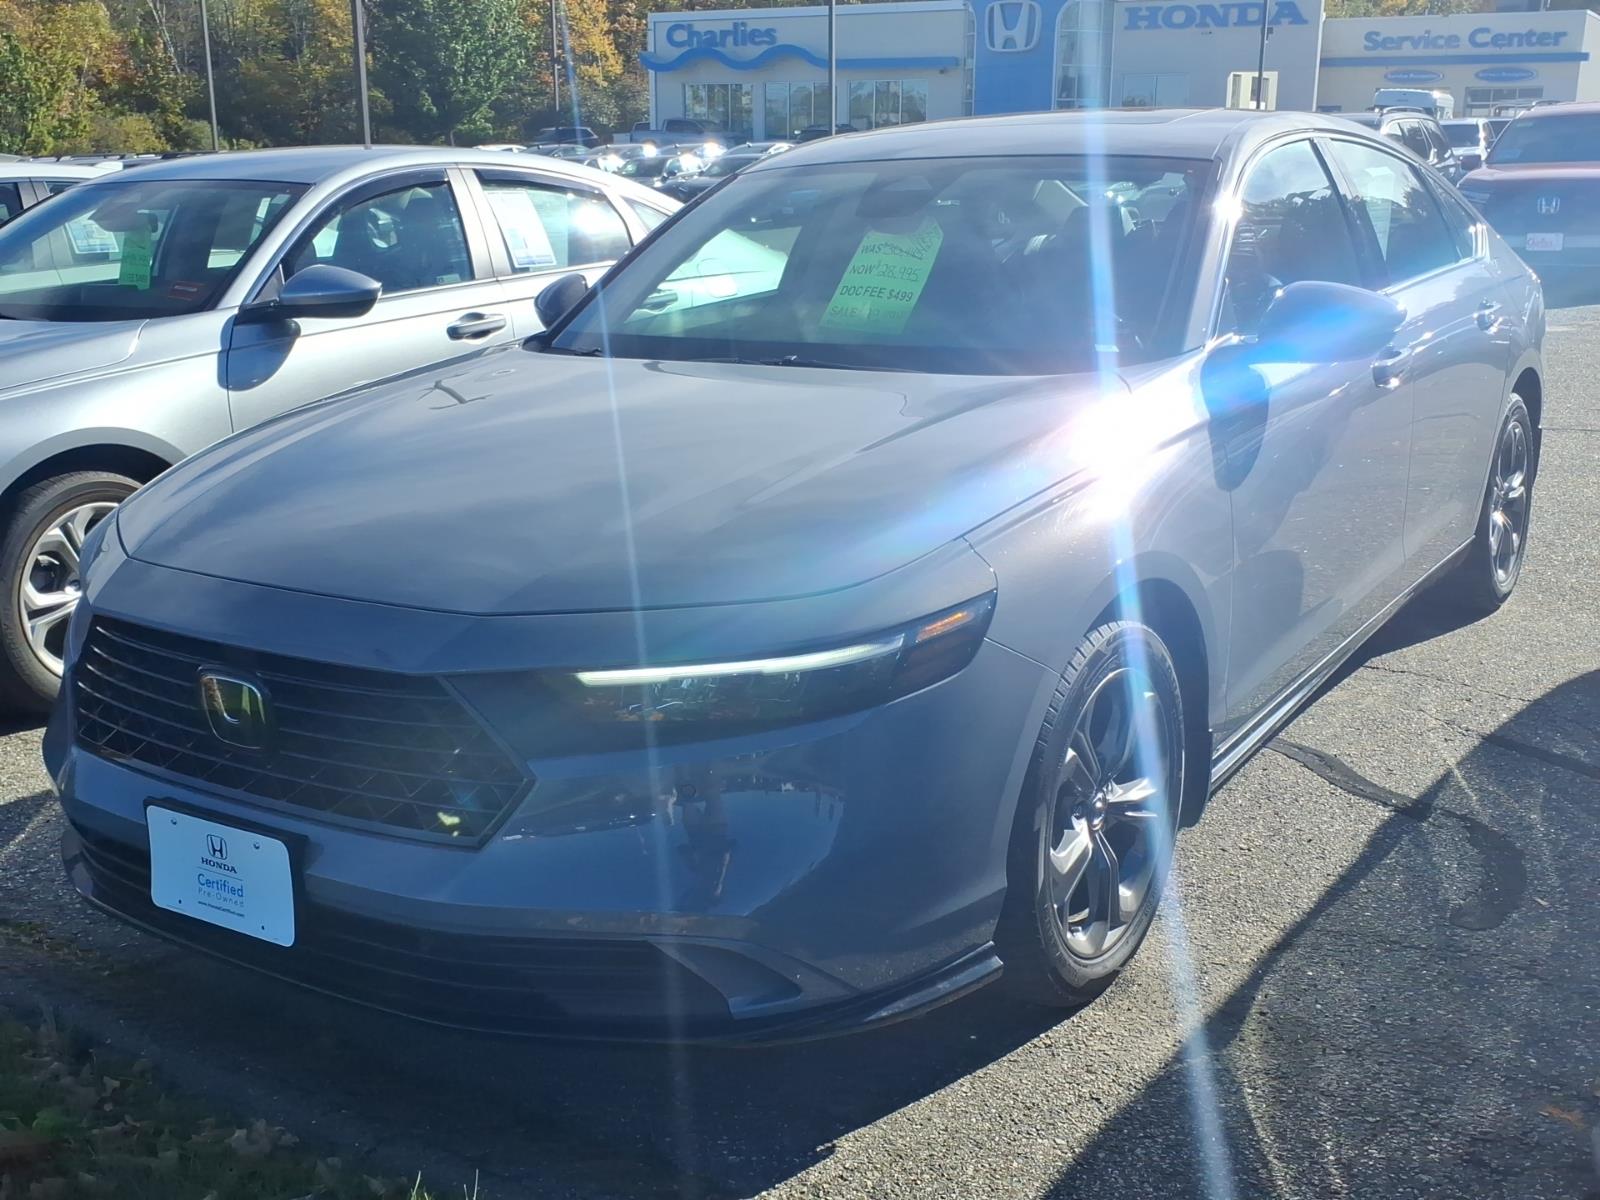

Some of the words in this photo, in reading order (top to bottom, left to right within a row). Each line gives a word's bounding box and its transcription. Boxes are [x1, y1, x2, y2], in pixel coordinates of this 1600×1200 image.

[1123, 0, 1309, 30] HONDA
[666, 21, 777, 48] Charlies
[1364, 29, 1460, 51] Service
[1468, 27, 1568, 49] Center
[861, 243, 883, 255] WAS
[849, 263, 876, 275] NOW
[887, 288, 914, 303] $499
[201, 856, 237, 874] HONDA
[197, 873, 244, 898] Certified
